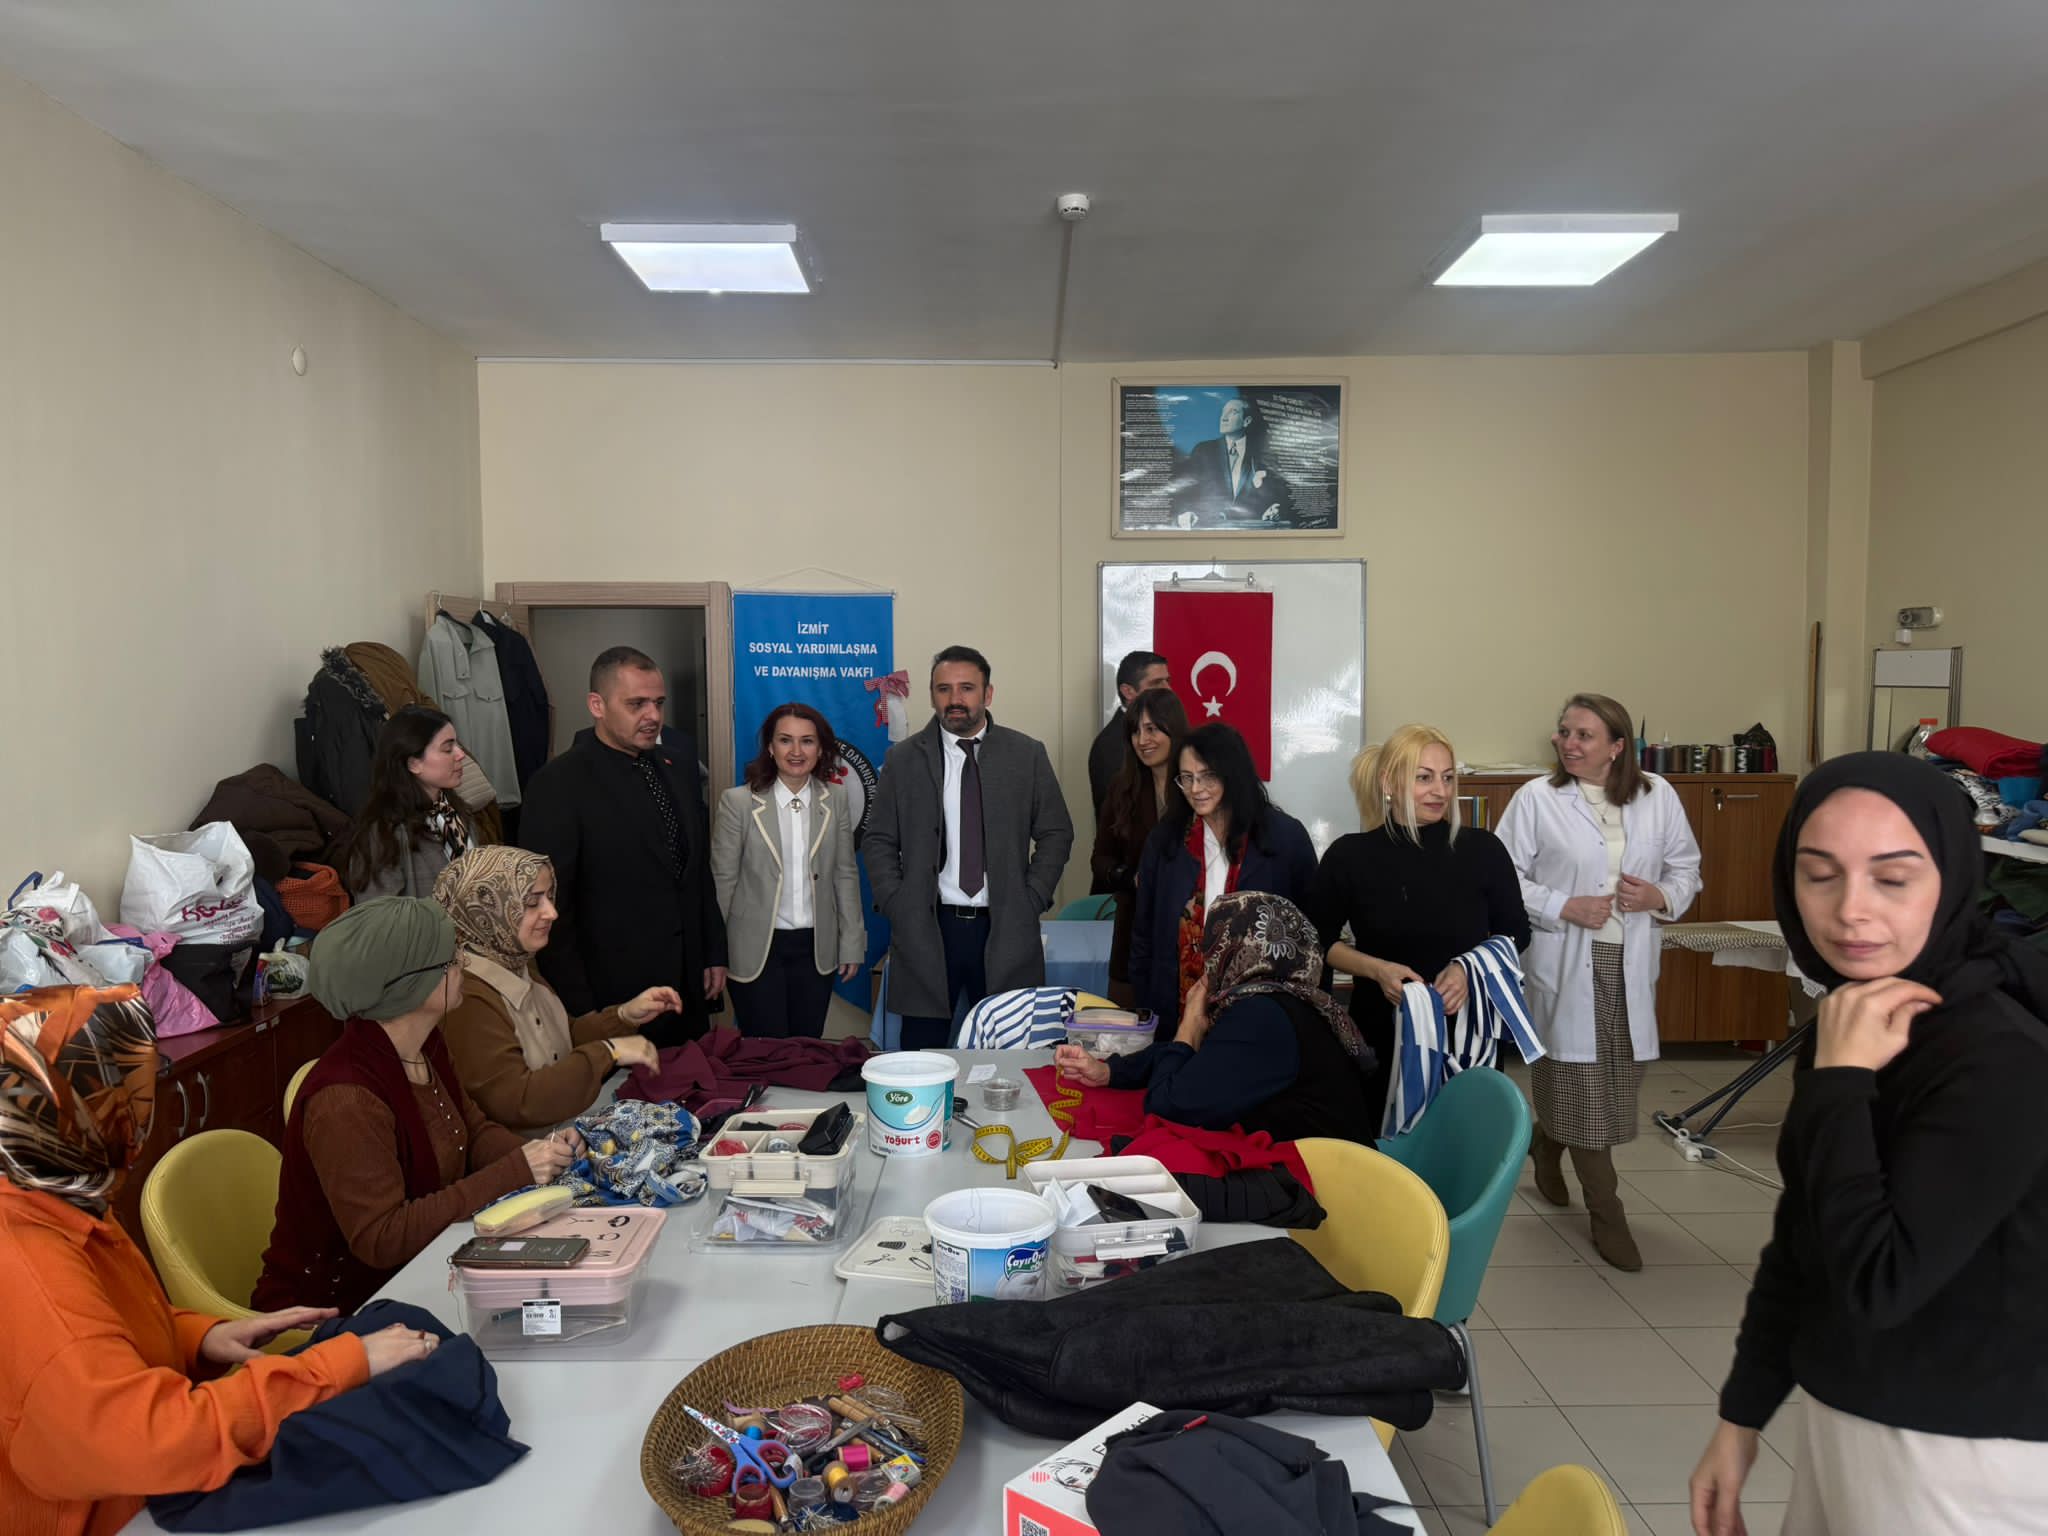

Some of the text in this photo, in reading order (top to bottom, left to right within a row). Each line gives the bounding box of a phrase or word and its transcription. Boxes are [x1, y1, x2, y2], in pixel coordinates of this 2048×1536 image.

[797, 621, 829, 635] İZMİT
[749, 642, 878, 656] SOSYAL YARDIMLAŞMA
[754, 666, 873, 680] VE DAYANIŞMA VAKFI
[890, 1092, 909, 1103] Yöre
[884, 1135, 921, 1146] Yoğurt
